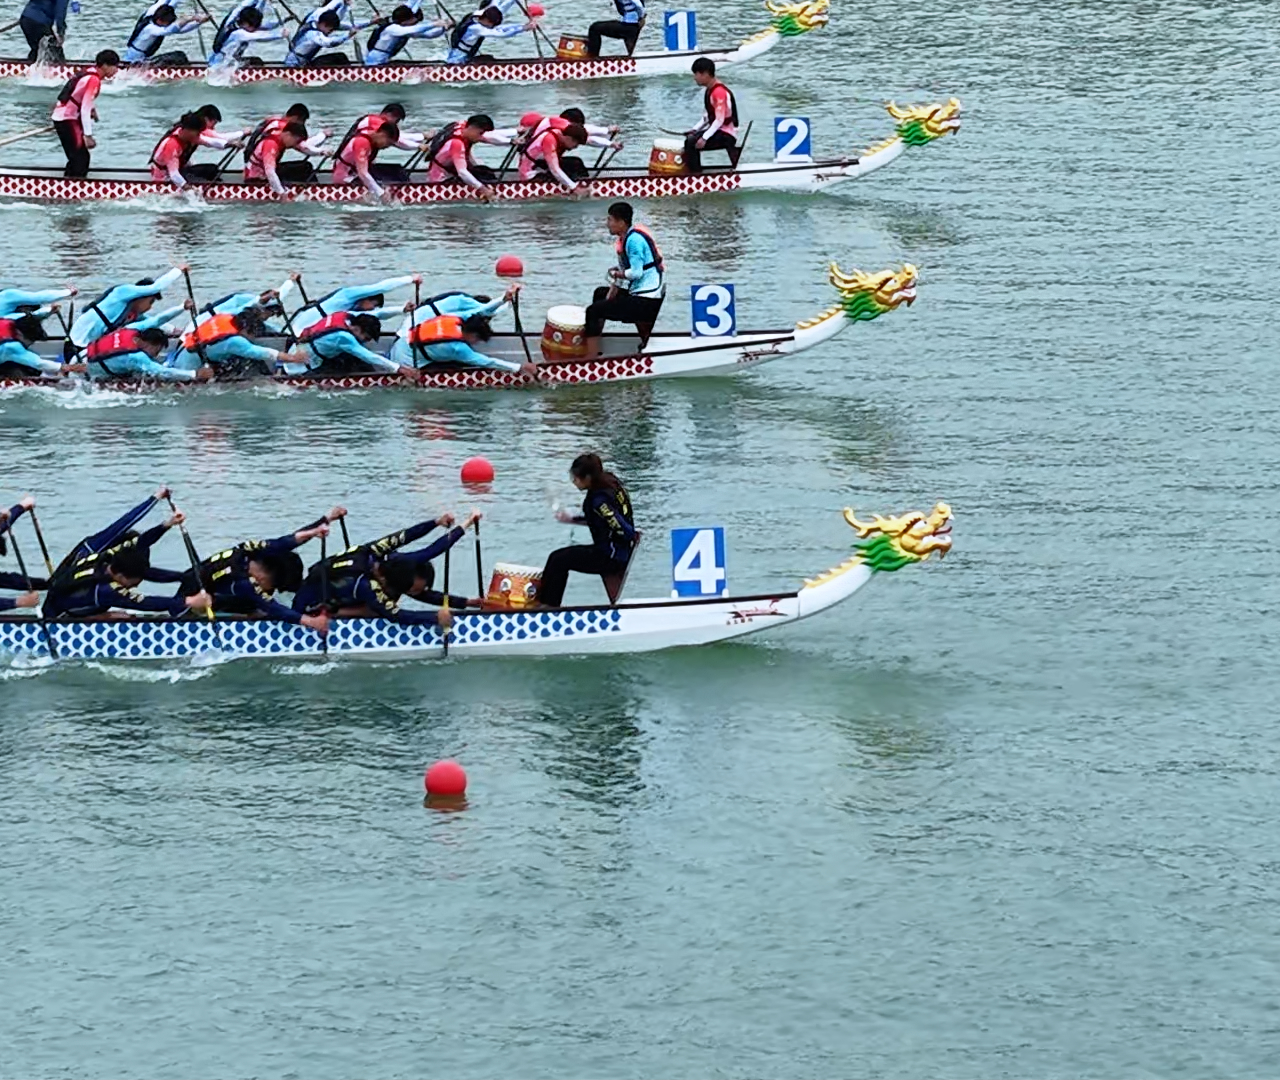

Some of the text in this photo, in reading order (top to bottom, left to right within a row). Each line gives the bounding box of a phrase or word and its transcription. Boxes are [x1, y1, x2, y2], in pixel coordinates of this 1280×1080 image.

[669, 12, 689, 50] 1
[776, 118, 810, 161] 2
[694, 285, 733, 335] 3
[674, 529, 725, 594] 4
